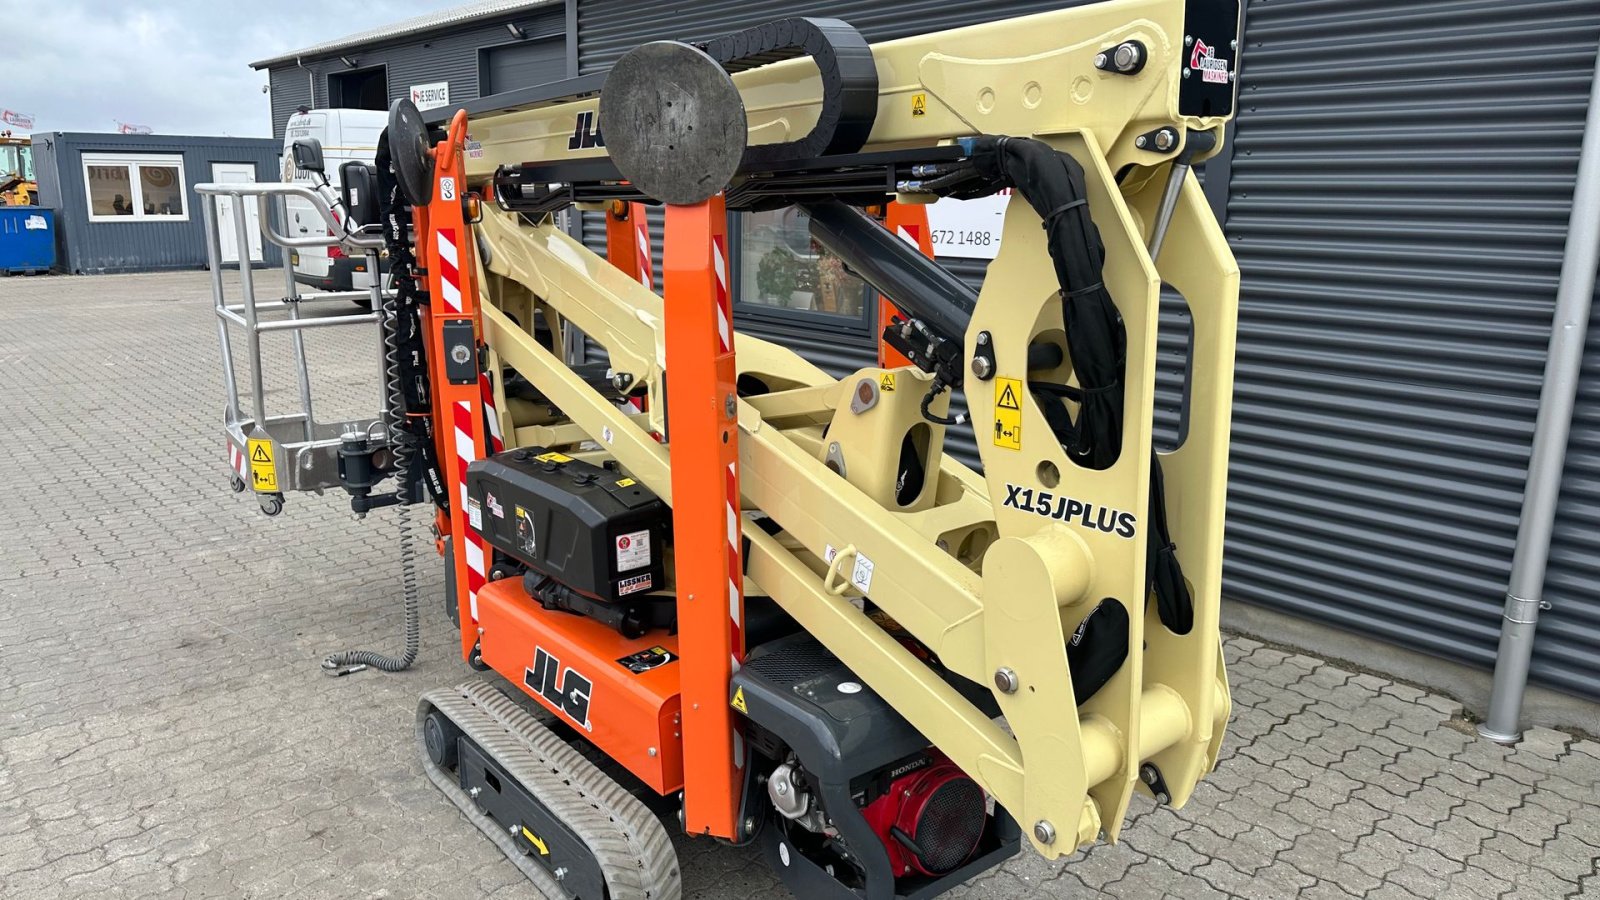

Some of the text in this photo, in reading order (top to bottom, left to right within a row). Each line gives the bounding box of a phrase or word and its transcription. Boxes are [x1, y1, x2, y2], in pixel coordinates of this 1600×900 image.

[425, 88, 446, 101] SERVICE
[567, 110, 607, 151] JL
[958, 231, 991, 246] 1488
[1003, 484, 1137, 539] X15JPLUS
[619, 574, 651, 589] LISSNER
[524, 645, 593, 729] JLG
[891, 757, 926, 777] HONDA
